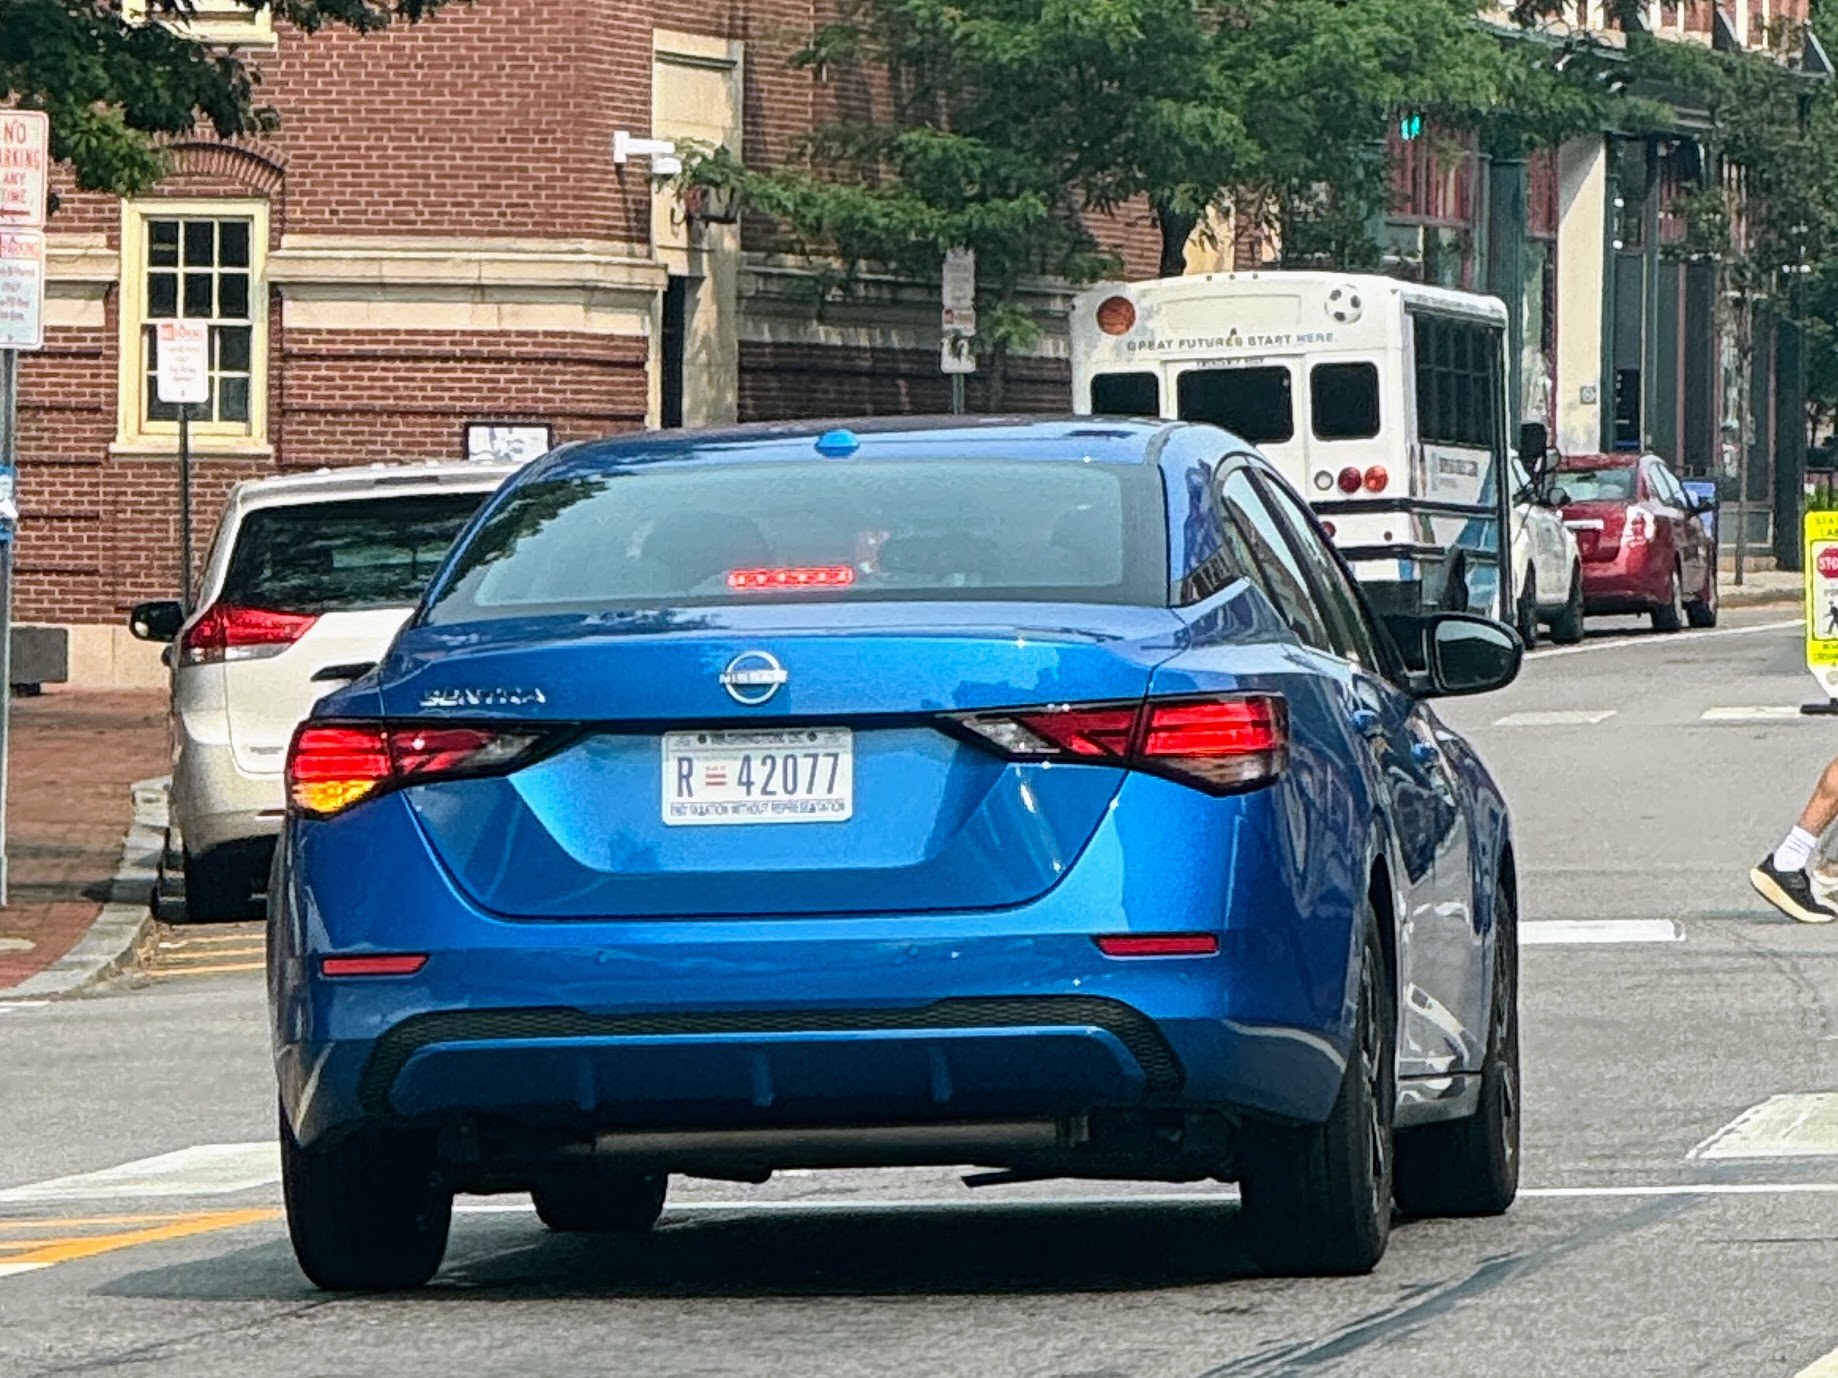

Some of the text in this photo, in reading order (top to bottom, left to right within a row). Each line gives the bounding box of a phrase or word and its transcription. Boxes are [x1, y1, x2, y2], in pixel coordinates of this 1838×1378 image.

[4, 122, 26, 144] NO
[0, 148, 40, 171] RKING
[1127, 338, 1173, 351] GREAT
[1178, 335, 1243, 350] FUTURES
[1248, 333, 1291, 348] START
[1815, 516, 1838, 525] STA
[1819, 556, 1838, 571] STO
[677, 752, 840, 798] R 42077
